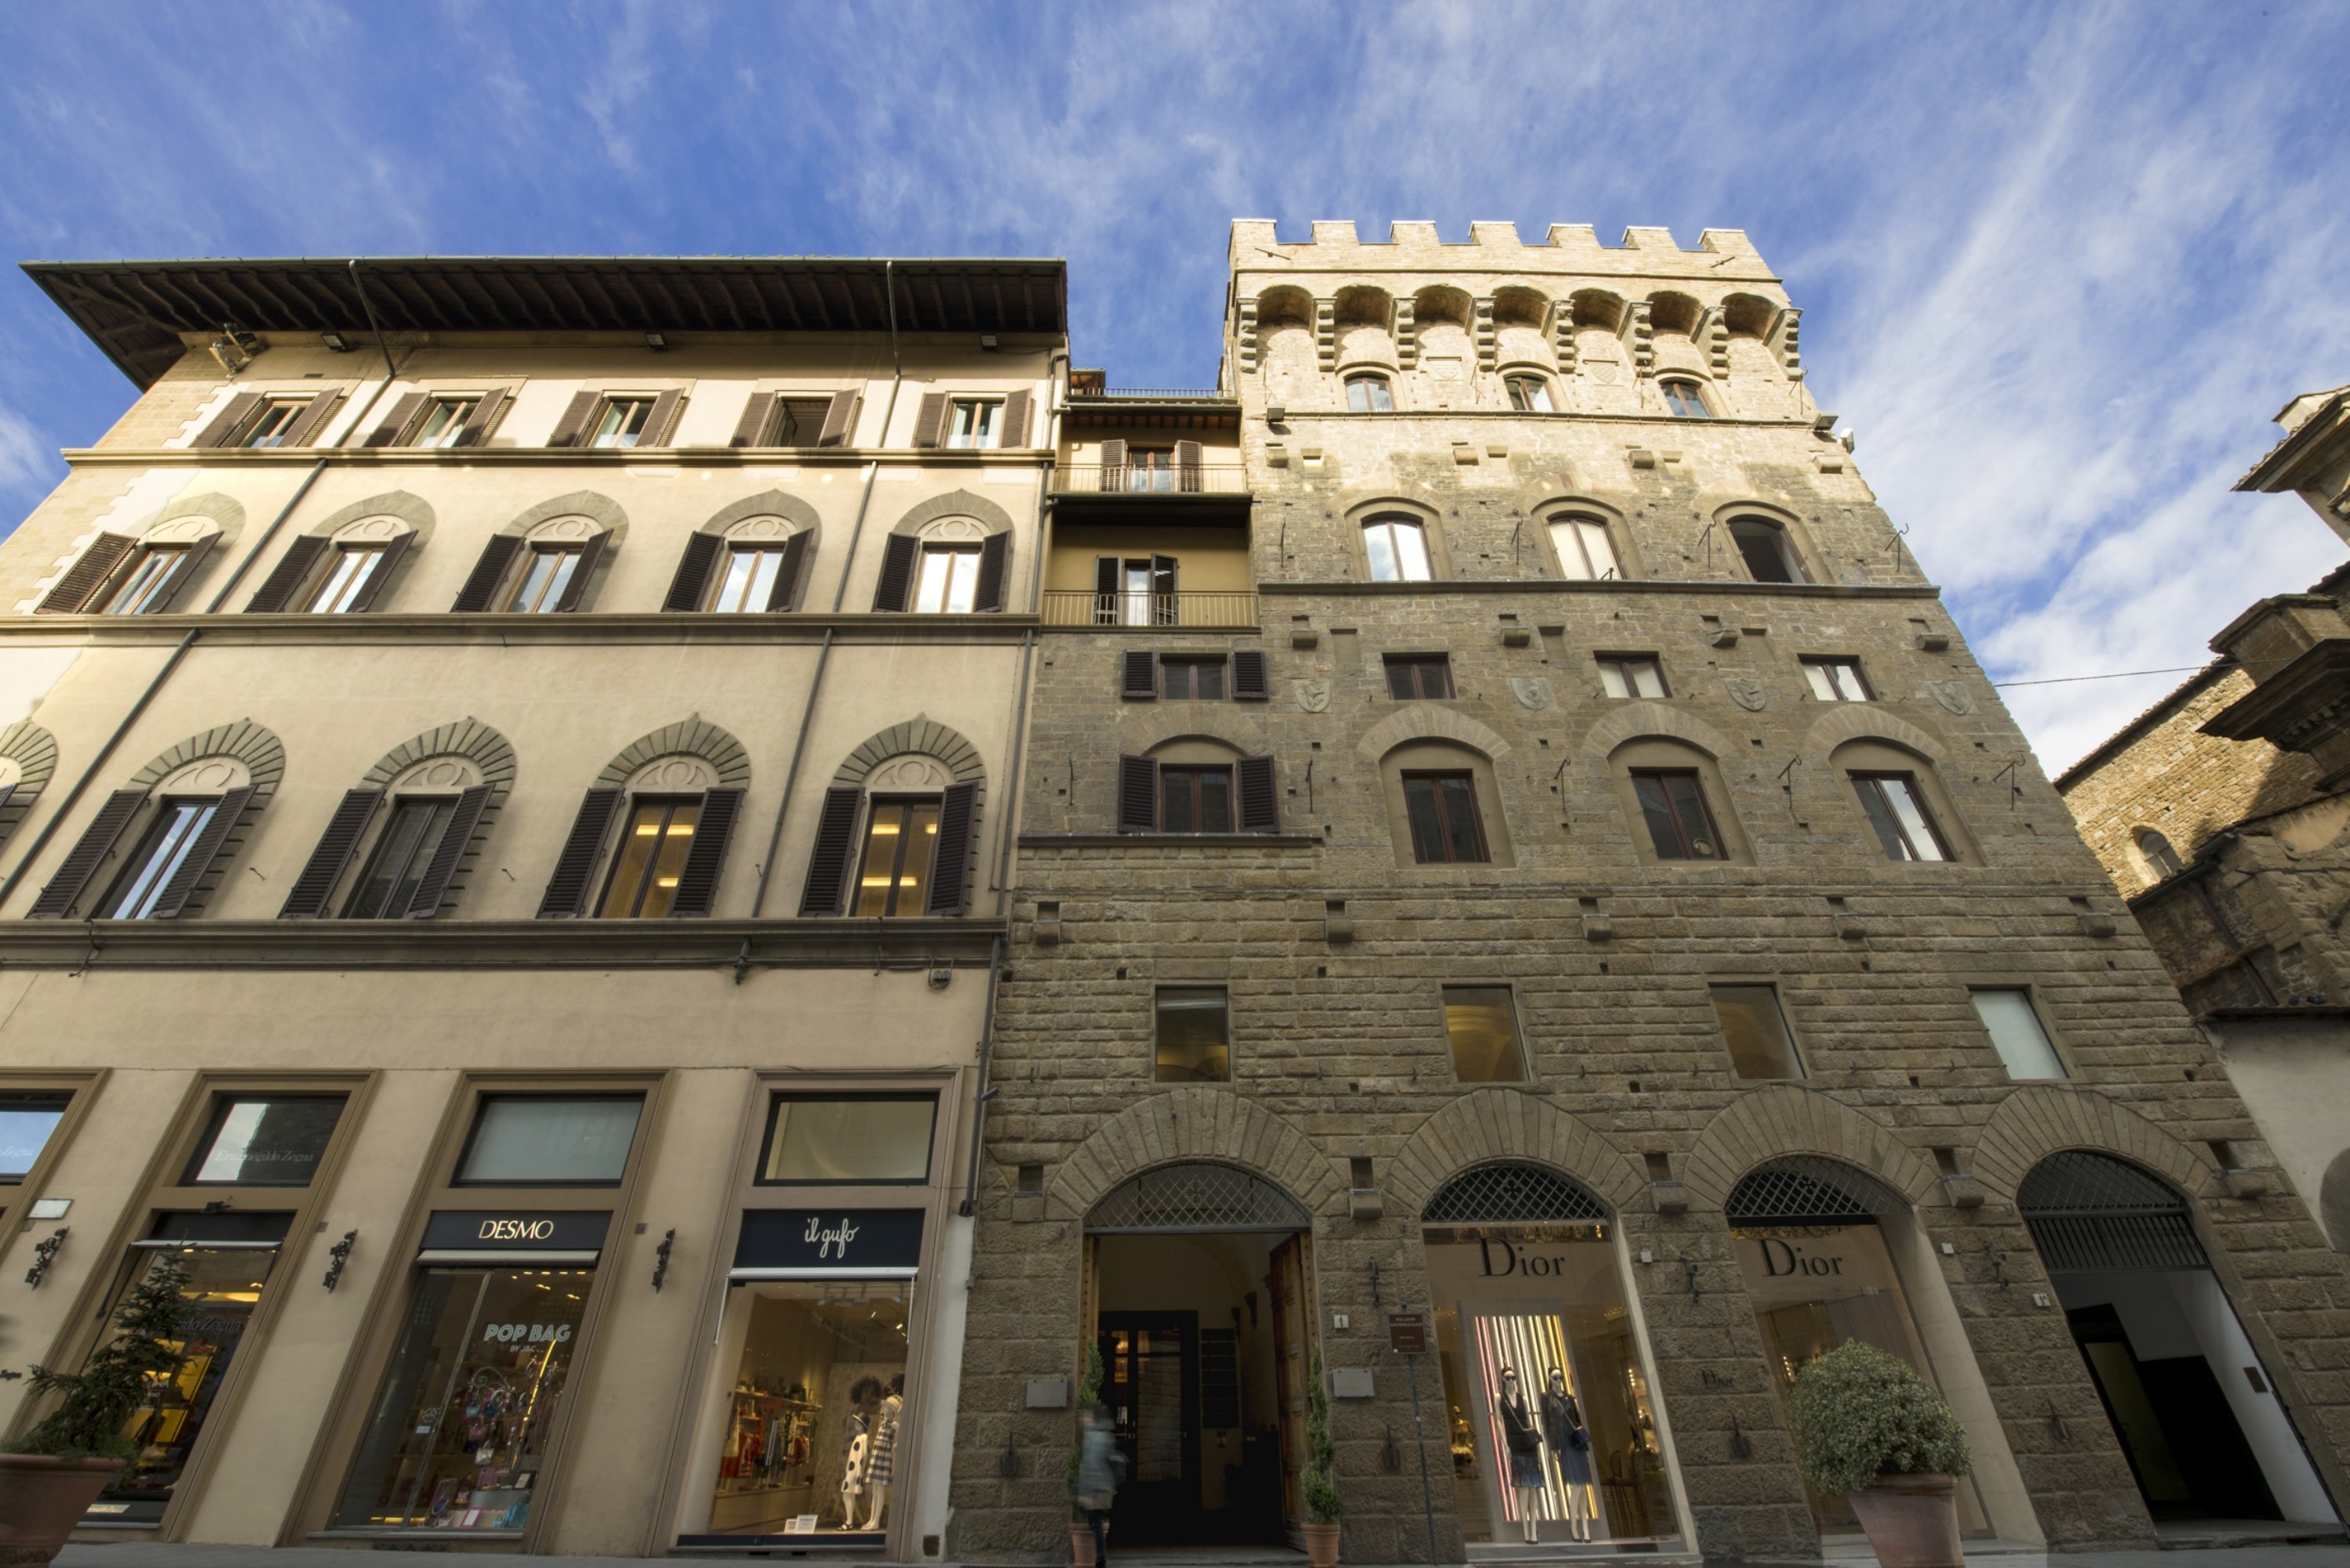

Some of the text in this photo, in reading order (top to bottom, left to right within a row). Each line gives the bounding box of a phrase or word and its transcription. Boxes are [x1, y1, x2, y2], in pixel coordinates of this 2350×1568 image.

[479, 1220, 554, 1239] DESMO
[804, 1217, 860, 1259] il gufo
[1477, 1237, 1565, 1277] Dior
[1755, 1238, 1842, 1277] Dior
[483, 1324, 570, 1342] POP BAG
